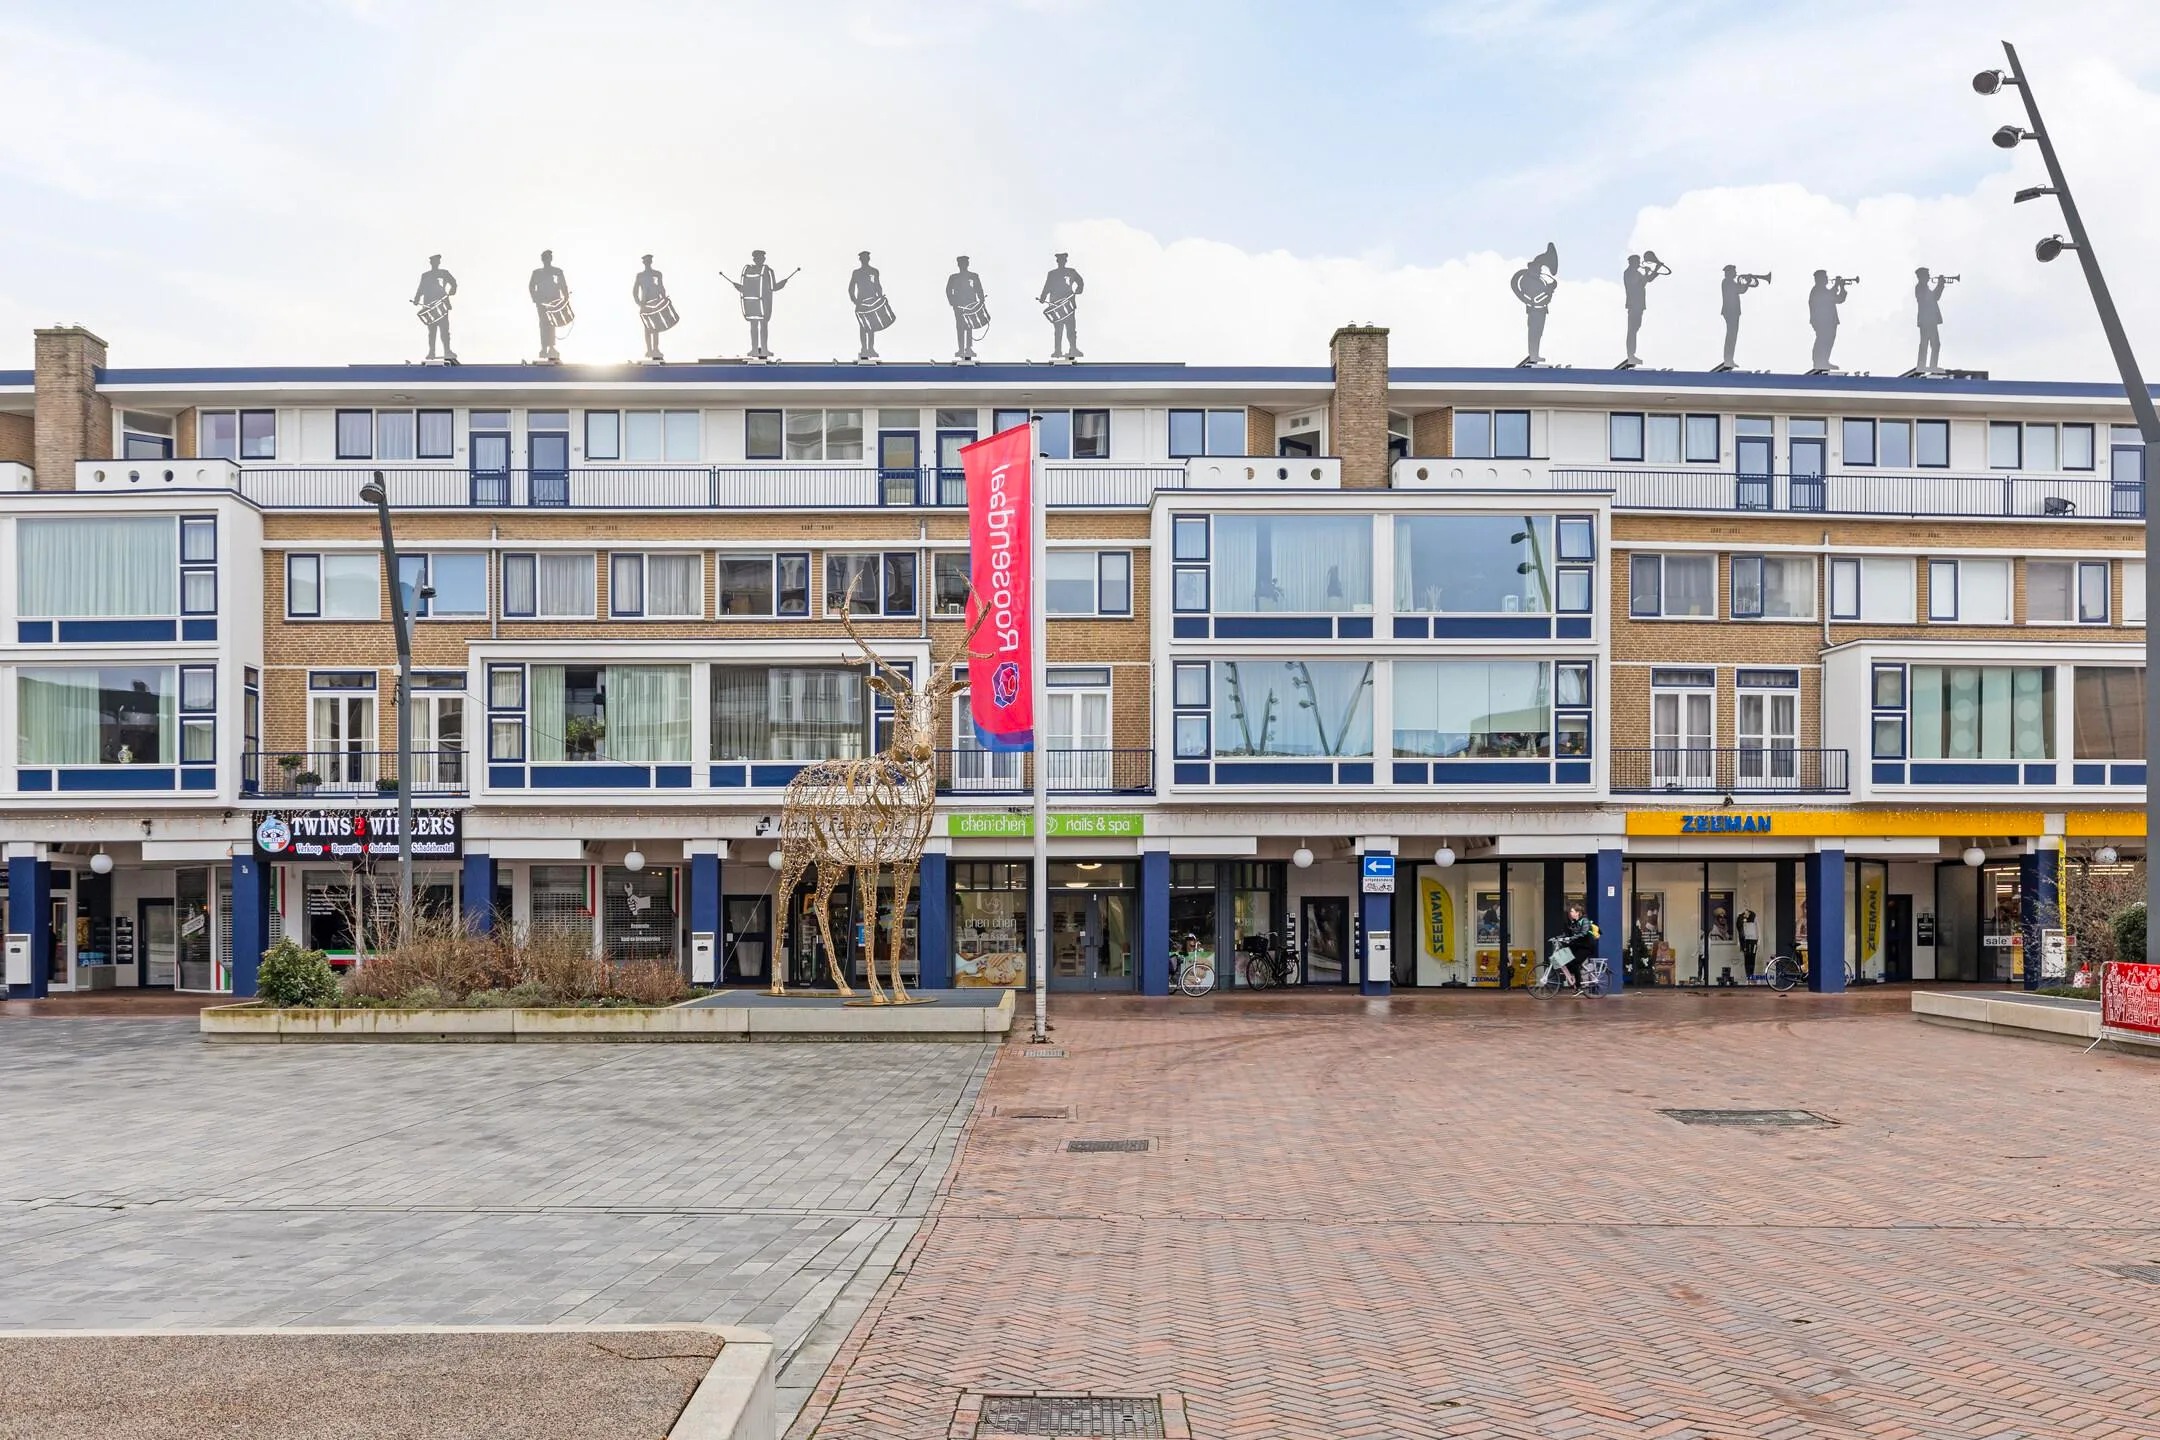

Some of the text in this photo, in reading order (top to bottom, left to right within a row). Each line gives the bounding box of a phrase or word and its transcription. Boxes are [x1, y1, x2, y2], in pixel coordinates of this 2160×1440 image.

[1066, 816, 1093, 832] nails
[1096, 817, 1105, 832] &
[1108, 819, 1130, 835] spa
[1681, 815, 1771, 833] ZEEMAN
[296, 843, 322, 855] Verkoop
[369, 842, 399, 854] Onderhou
[1867, 890, 1877, 951] ZEEMAN
[1985, 937, 2007, 945] sale
